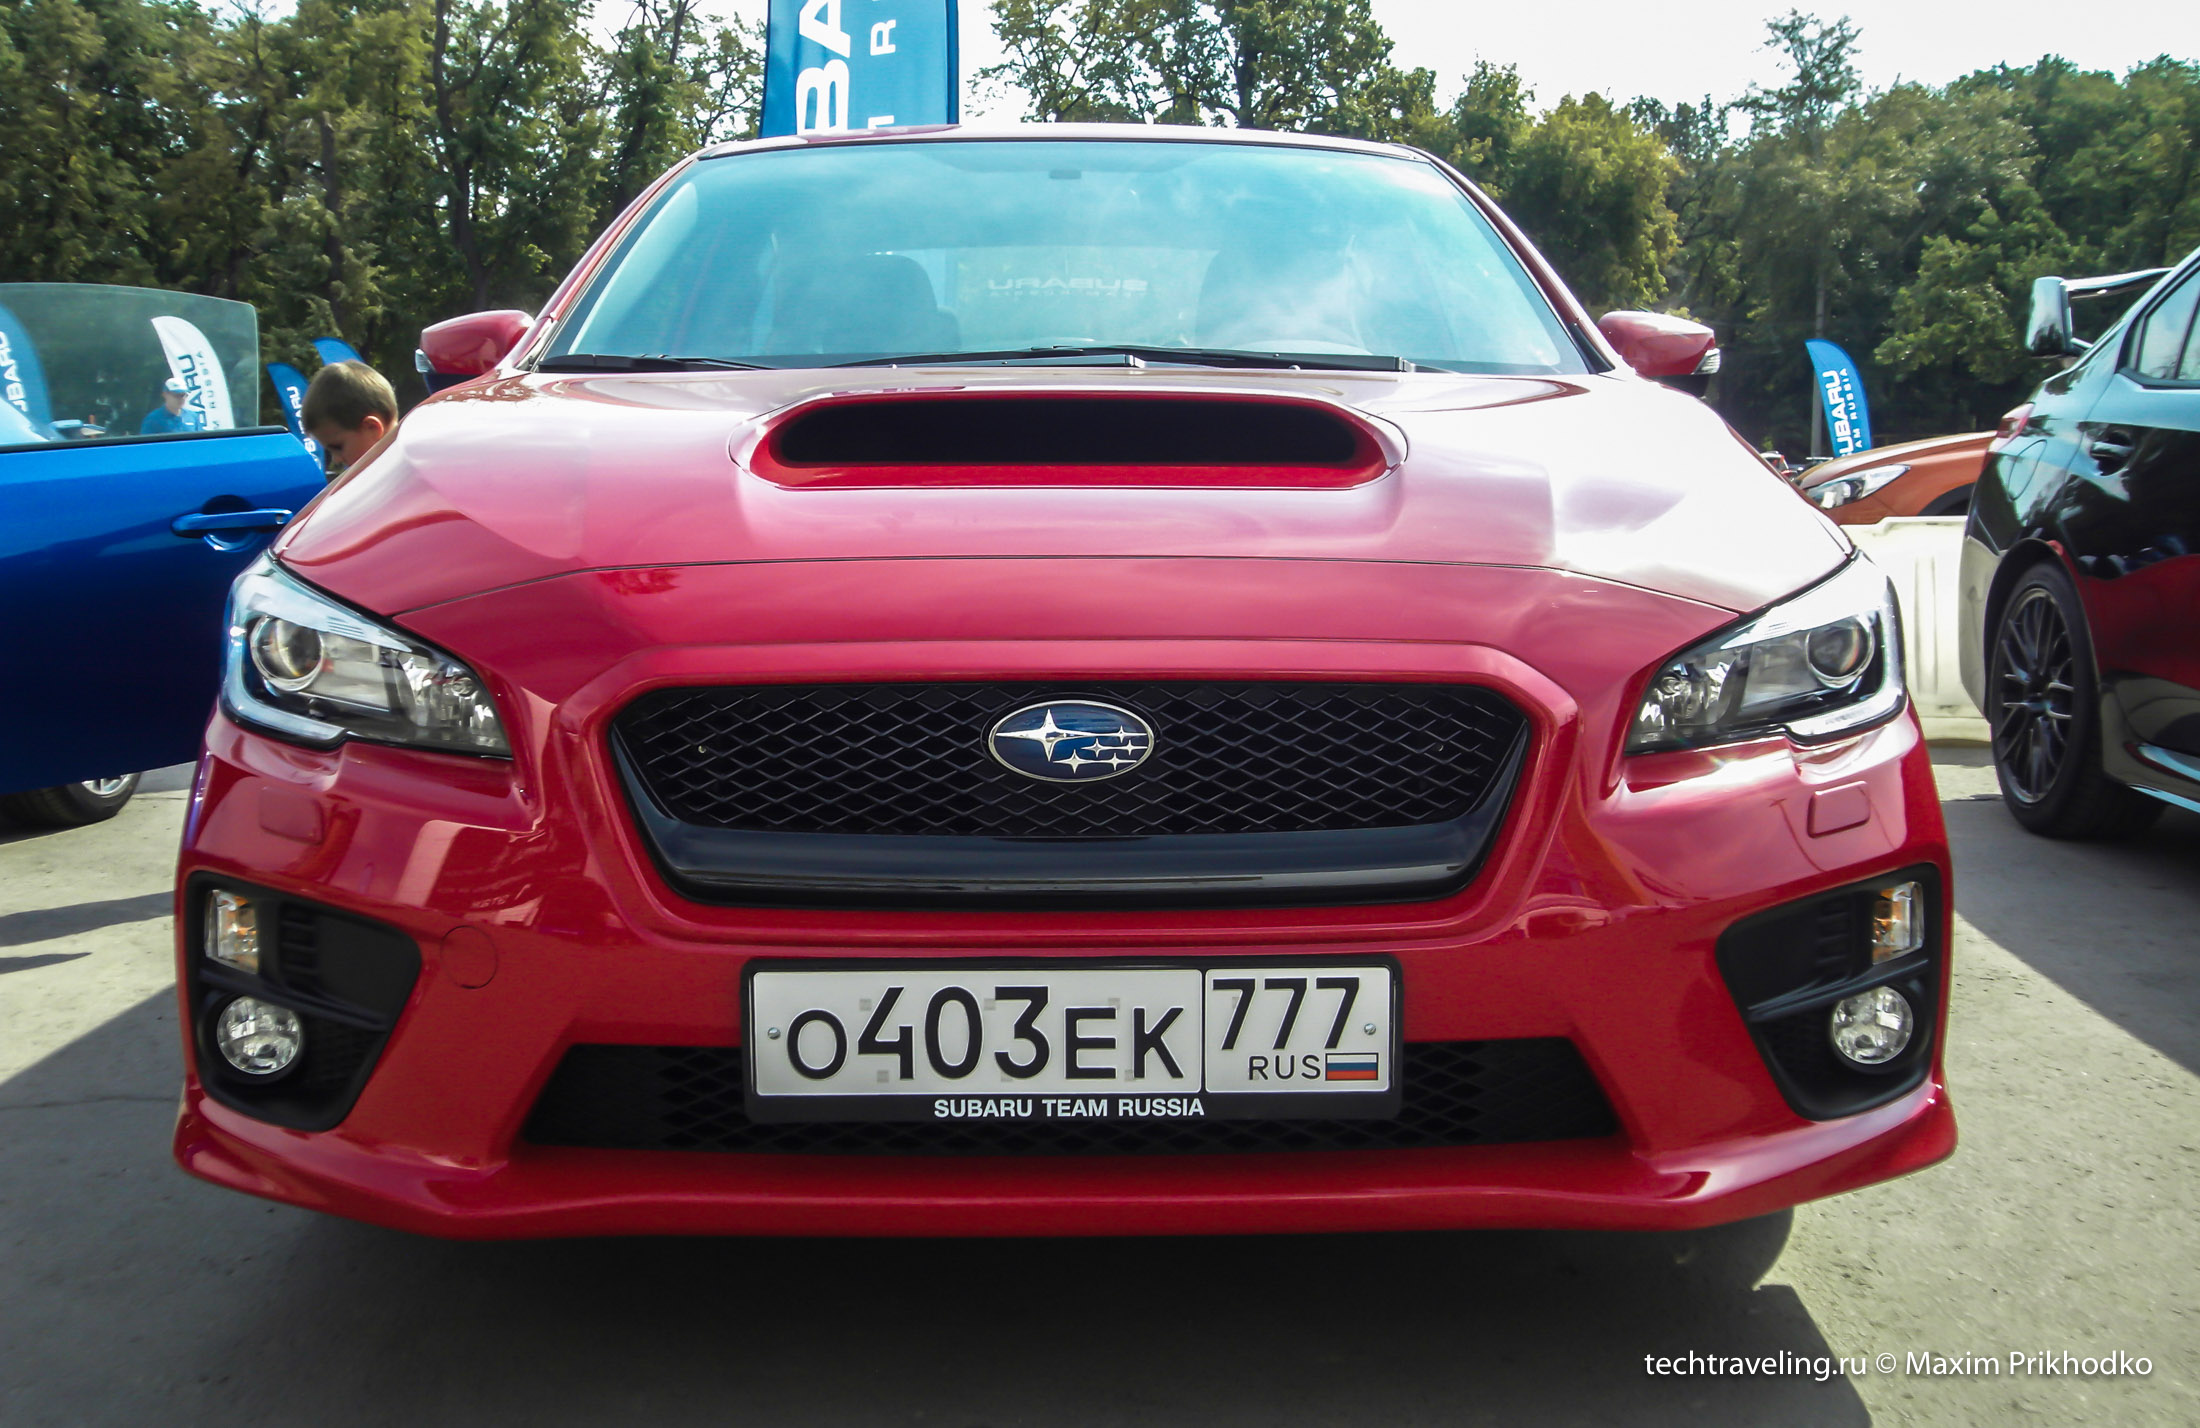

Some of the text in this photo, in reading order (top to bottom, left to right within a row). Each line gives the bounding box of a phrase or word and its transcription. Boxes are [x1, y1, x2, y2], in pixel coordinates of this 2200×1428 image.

[1822, 370, 1855, 457] UBARU
[1840, 368, 1857, 420] RUSSIA
[1213, 977, 1360, 1051] 777
[1249, 1055, 1321, 1081] RUS
[934, 1098, 1205, 1118] SUBARU TEAM RUSSIA
